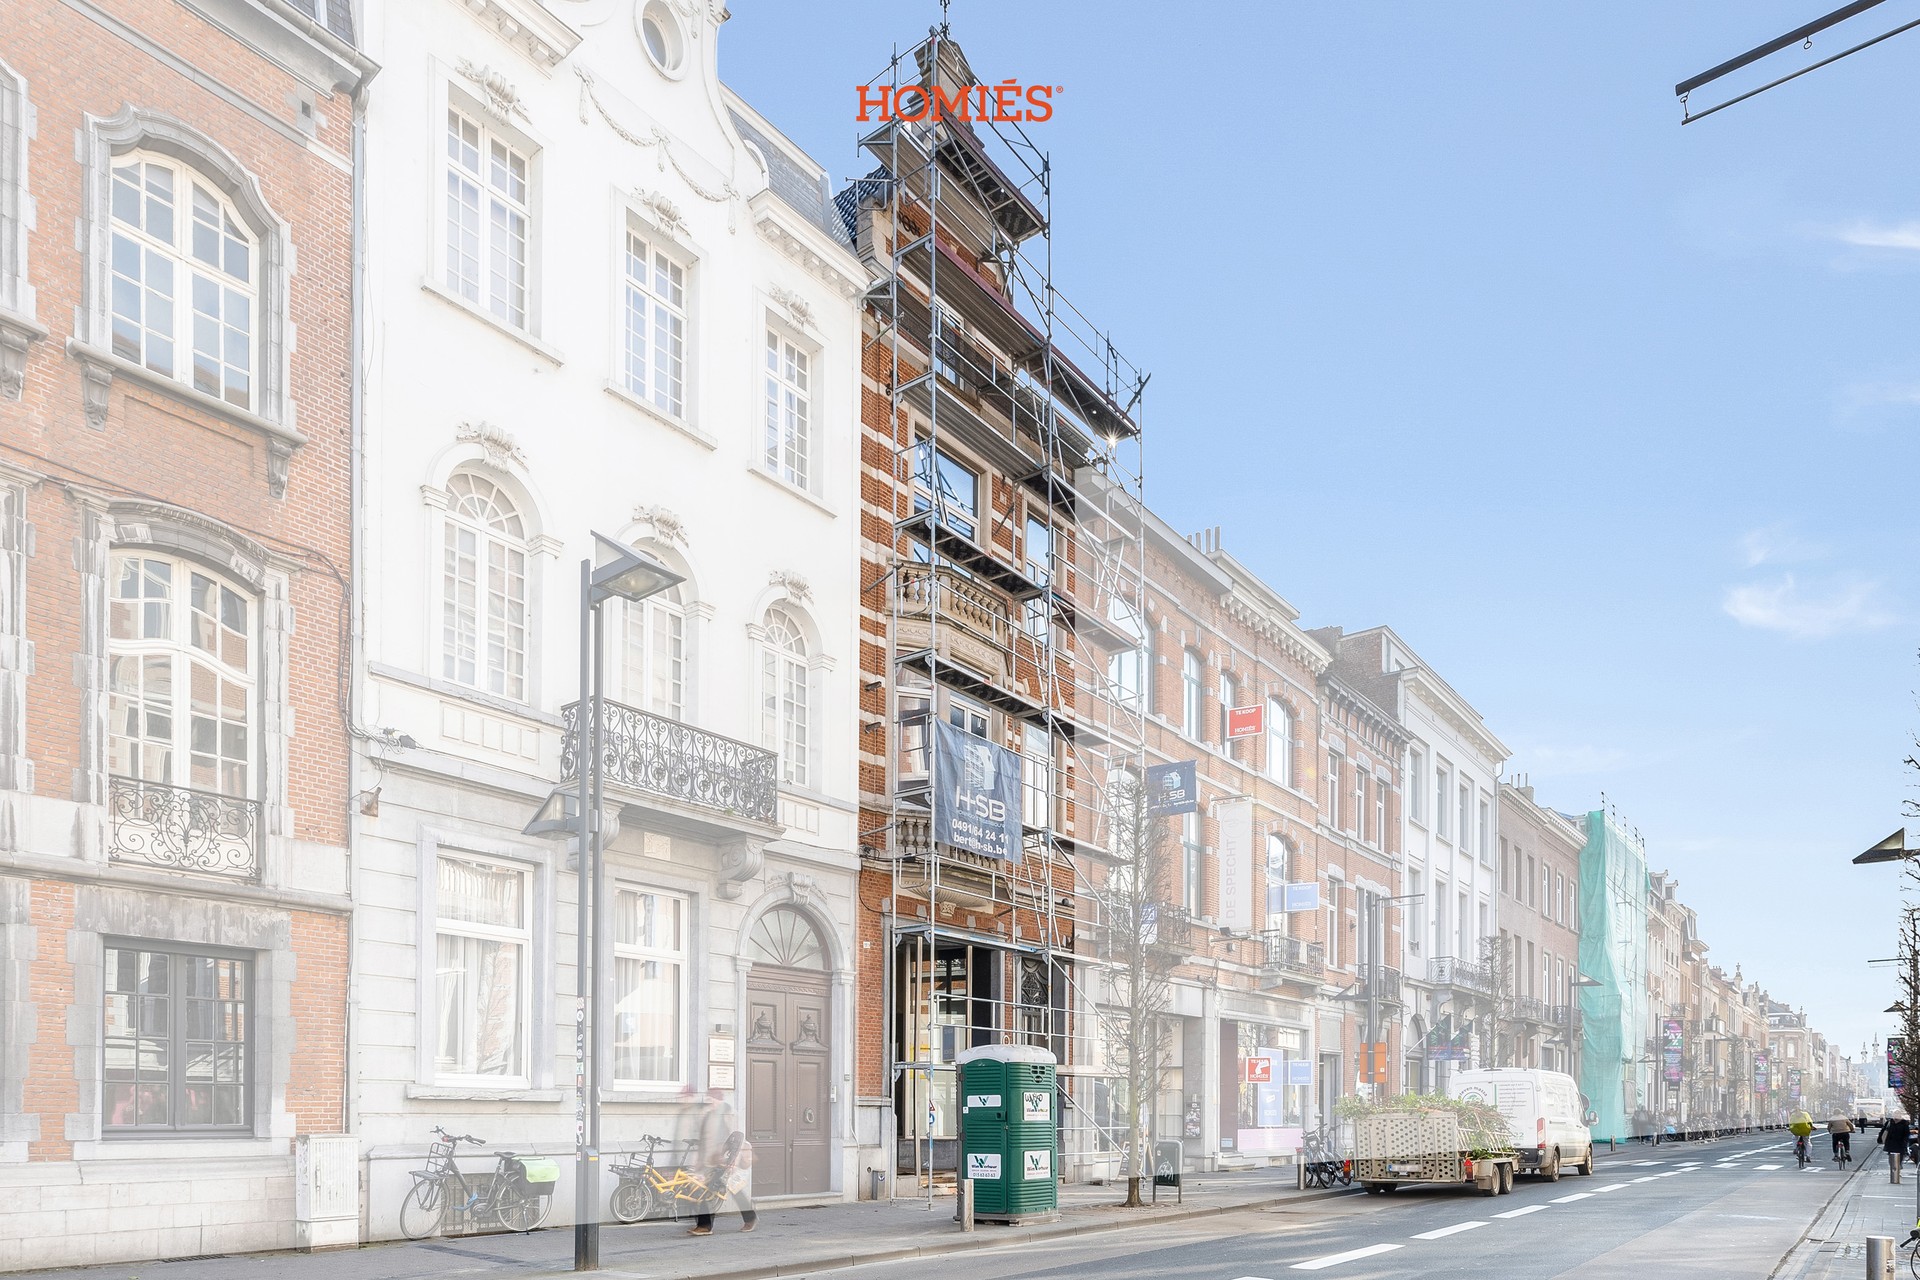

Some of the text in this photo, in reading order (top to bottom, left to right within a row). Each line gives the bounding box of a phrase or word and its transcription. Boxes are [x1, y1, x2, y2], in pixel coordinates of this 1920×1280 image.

[952, 819, 1009, 845] 0491/64 24 11
[953, 831, 1008, 856] bert@h-sb.be
[1226, 839, 1237, 919] DE SPECHT
